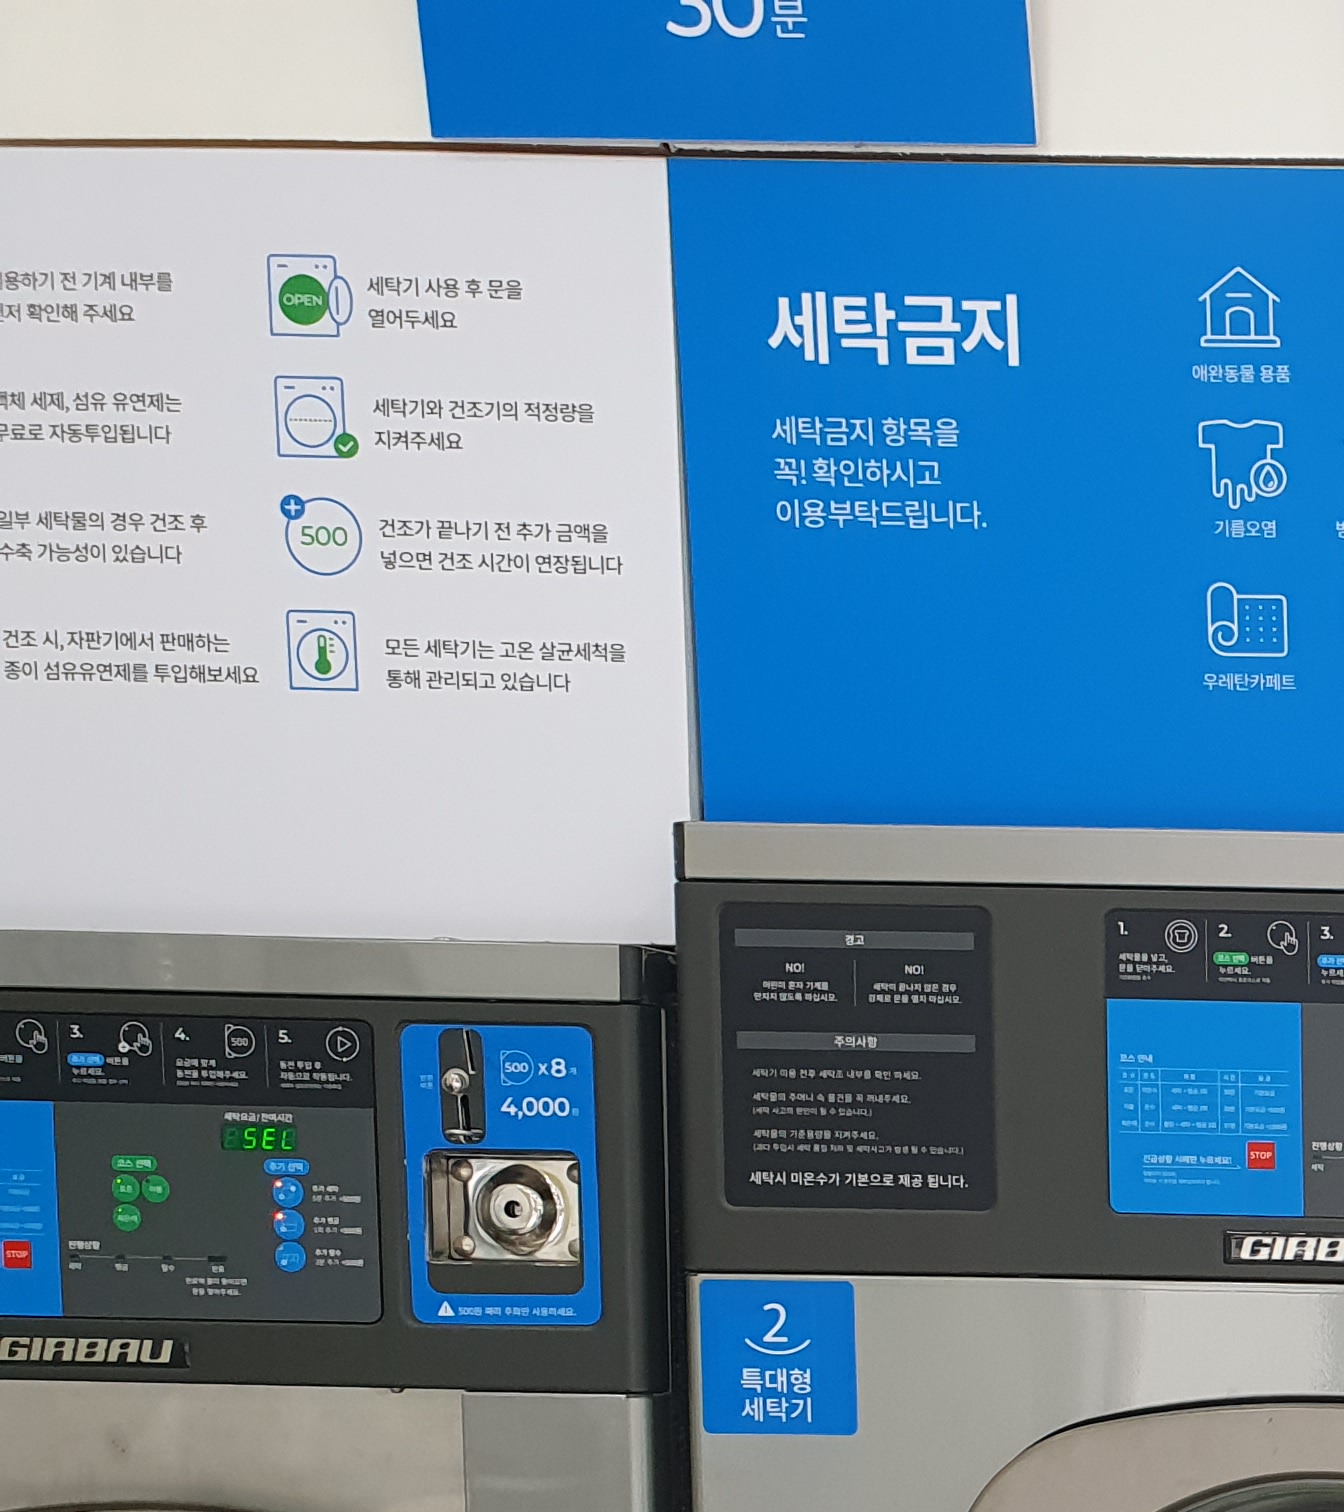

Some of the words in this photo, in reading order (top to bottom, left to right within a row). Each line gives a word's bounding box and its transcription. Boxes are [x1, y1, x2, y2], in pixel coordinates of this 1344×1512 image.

[367, 277, 419, 297] 세탁기
[425, 278, 459, 298] 사용
[465, 279, 483, 298] 후
[487, 280, 522, 300] 문을
[283, 294, 322, 307] OPEN
[368, 309, 457, 330] 열어두세요
[768, 291, 1019, 366] 세탁금지
[1192, 365, 1254, 382] 애완동물
[1260, 365, 1290, 383] 용품
[772, 416, 873, 446] 세탁금지
[882, 417, 959, 447] 항목을
[774, 459, 806, 486] 꼭!
[813, 458, 941, 487] 확인하시고
[777, 499, 986, 529] 이용부탁드립니다.
[301, 526, 347, 546] 500
[379, 519, 431, 539] 건조가
[437, 520, 488, 540] 끝나기
[495, 522, 511, 540] 전
[517, 522, 551, 542] 추가
[556, 524, 608, 543] 금액을
[1215, 520, 1276, 538] 기름오염
[1203, 673, 1296, 690] 우레탄카페트
[786, 963, 804, 972] NO!
[905, 965, 924, 974] NO!
[834, 1036, 877, 1048] 주의사항
[504, 1062, 529, 1073] 500
[1249, 1150, 1273, 1160] STOP
[750, 1171, 786, 1185] 세탁시
[791, 1172, 839, 1186] 미온수가
[845, 1173, 894, 1186] 기본으로
[928, 1175, 968, 1188] 됩니다.
[5, 1250, 29, 1259] STOP
[763, 1303, 788, 1342] 2
[0, 1337, 173, 1362] GIRBAU
[741, 1368, 811, 1393] 특대형
[742, 1397, 811, 1422] 세탁기
